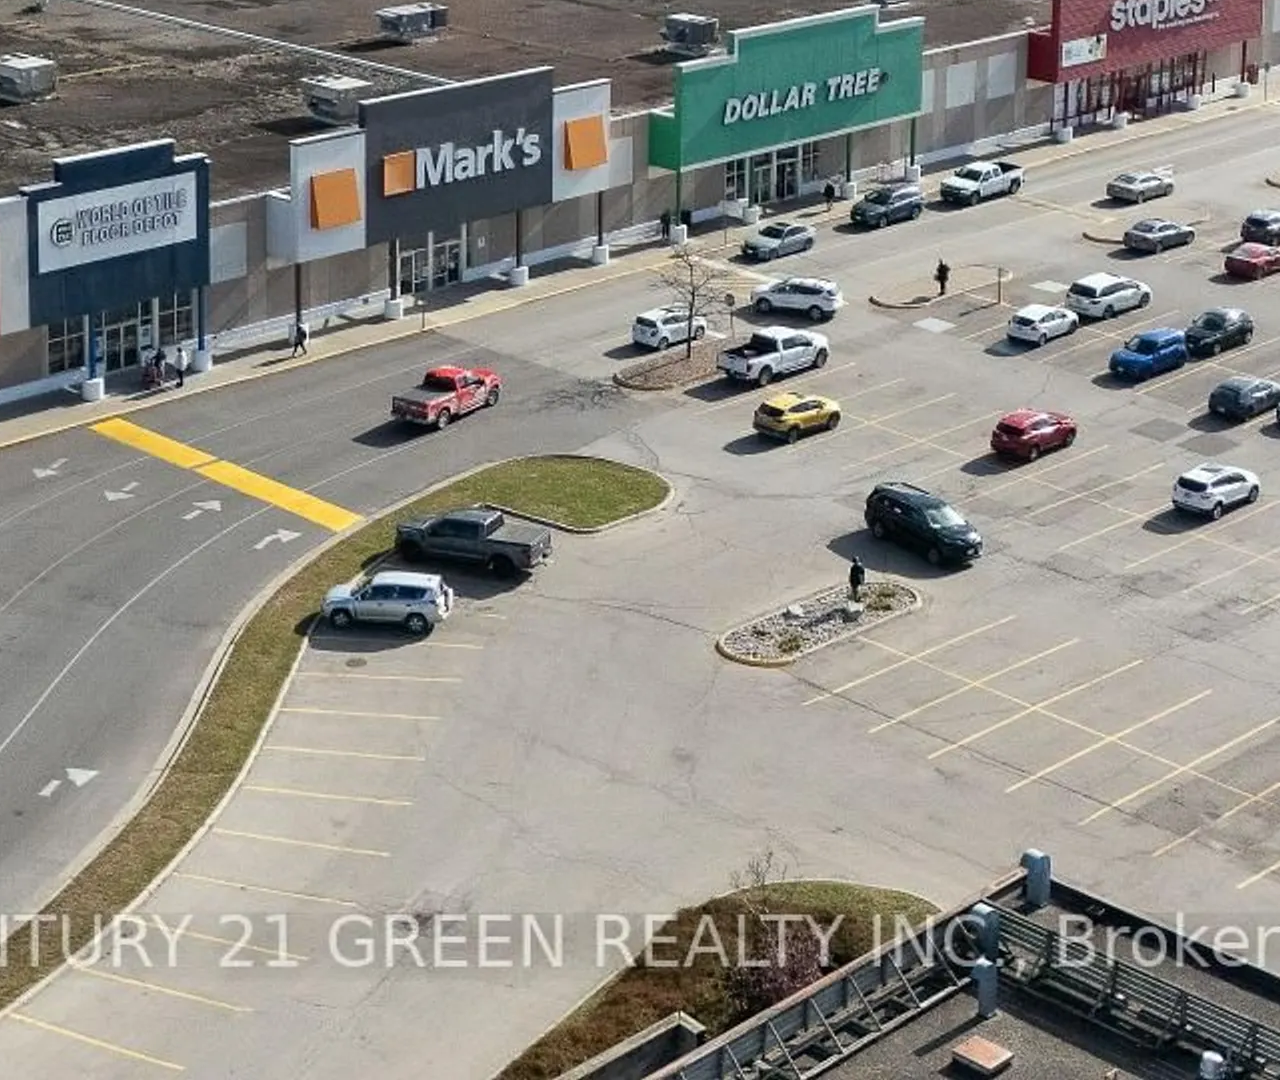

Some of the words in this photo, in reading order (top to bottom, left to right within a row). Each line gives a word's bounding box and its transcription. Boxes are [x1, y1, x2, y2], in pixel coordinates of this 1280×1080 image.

[724, 82, 818, 125] DOLLAR
[826, 68, 881, 102] TREE
[416, 127, 541, 189] Mark's
